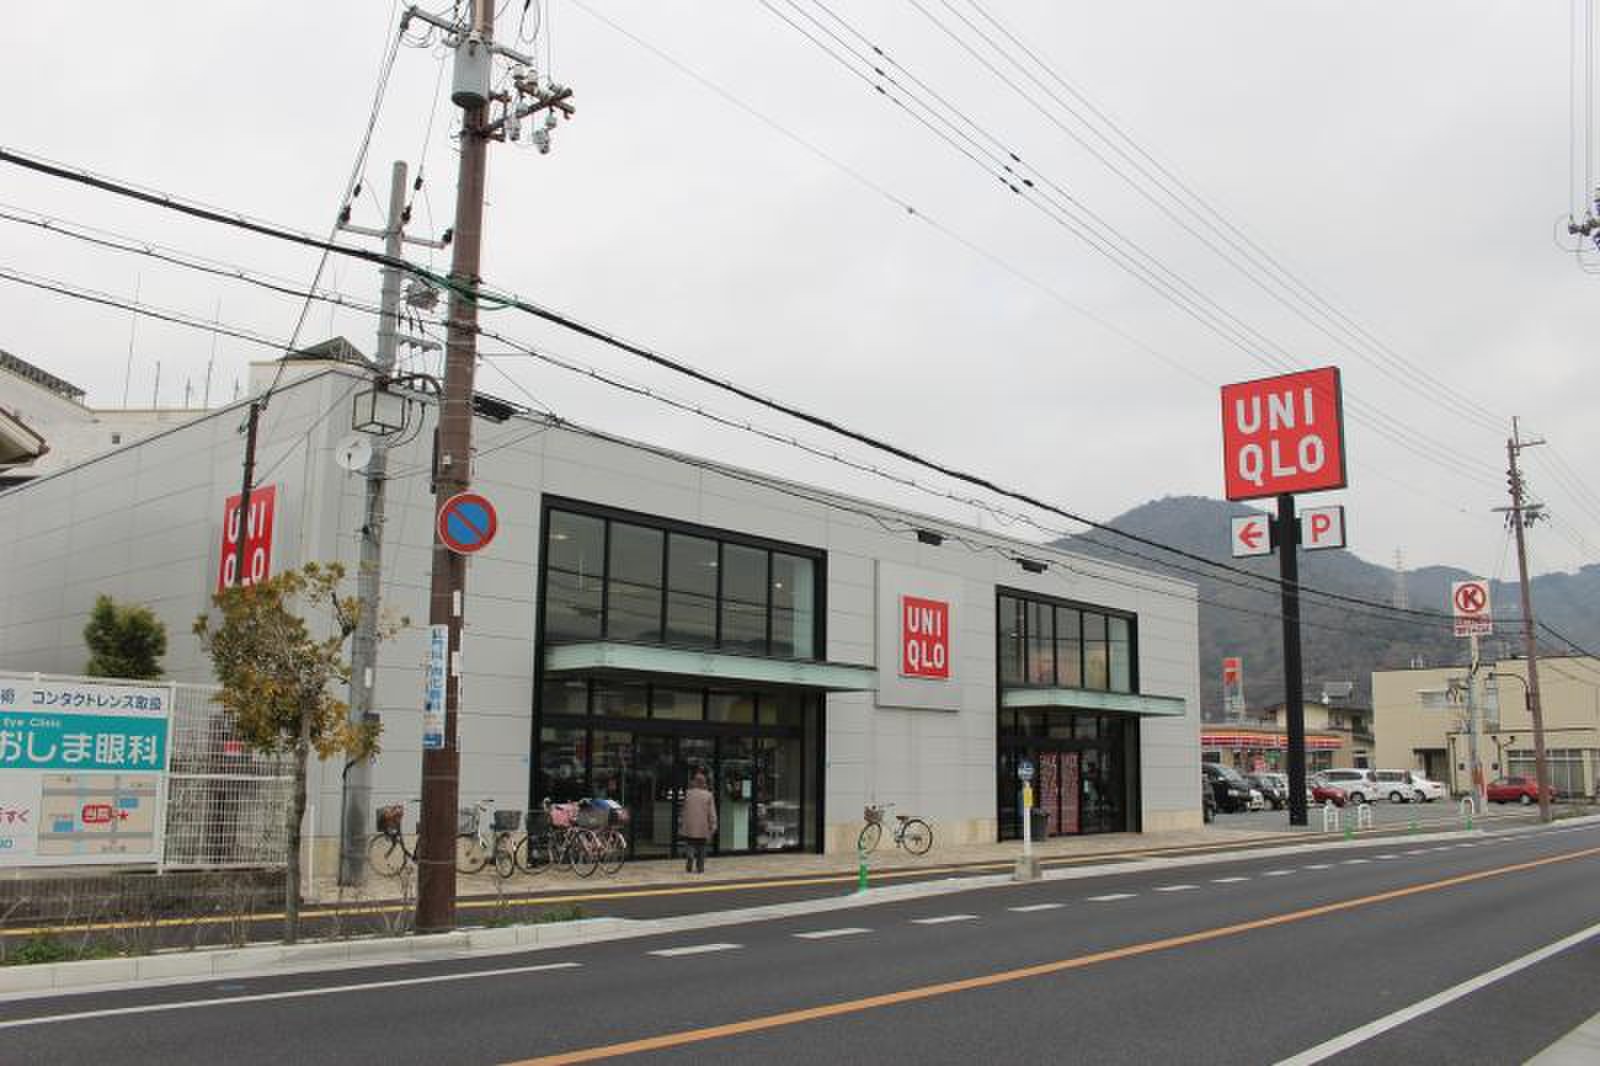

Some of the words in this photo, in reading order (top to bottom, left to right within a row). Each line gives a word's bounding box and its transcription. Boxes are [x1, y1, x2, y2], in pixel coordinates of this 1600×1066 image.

[1236, 387, 1315, 434] UNI
[1238, 434, 1325, 487] QLO
[1311, 514, 1330, 544] P
[908, 606, 942, 638] UNI
[908, 639, 945, 672] QLO
